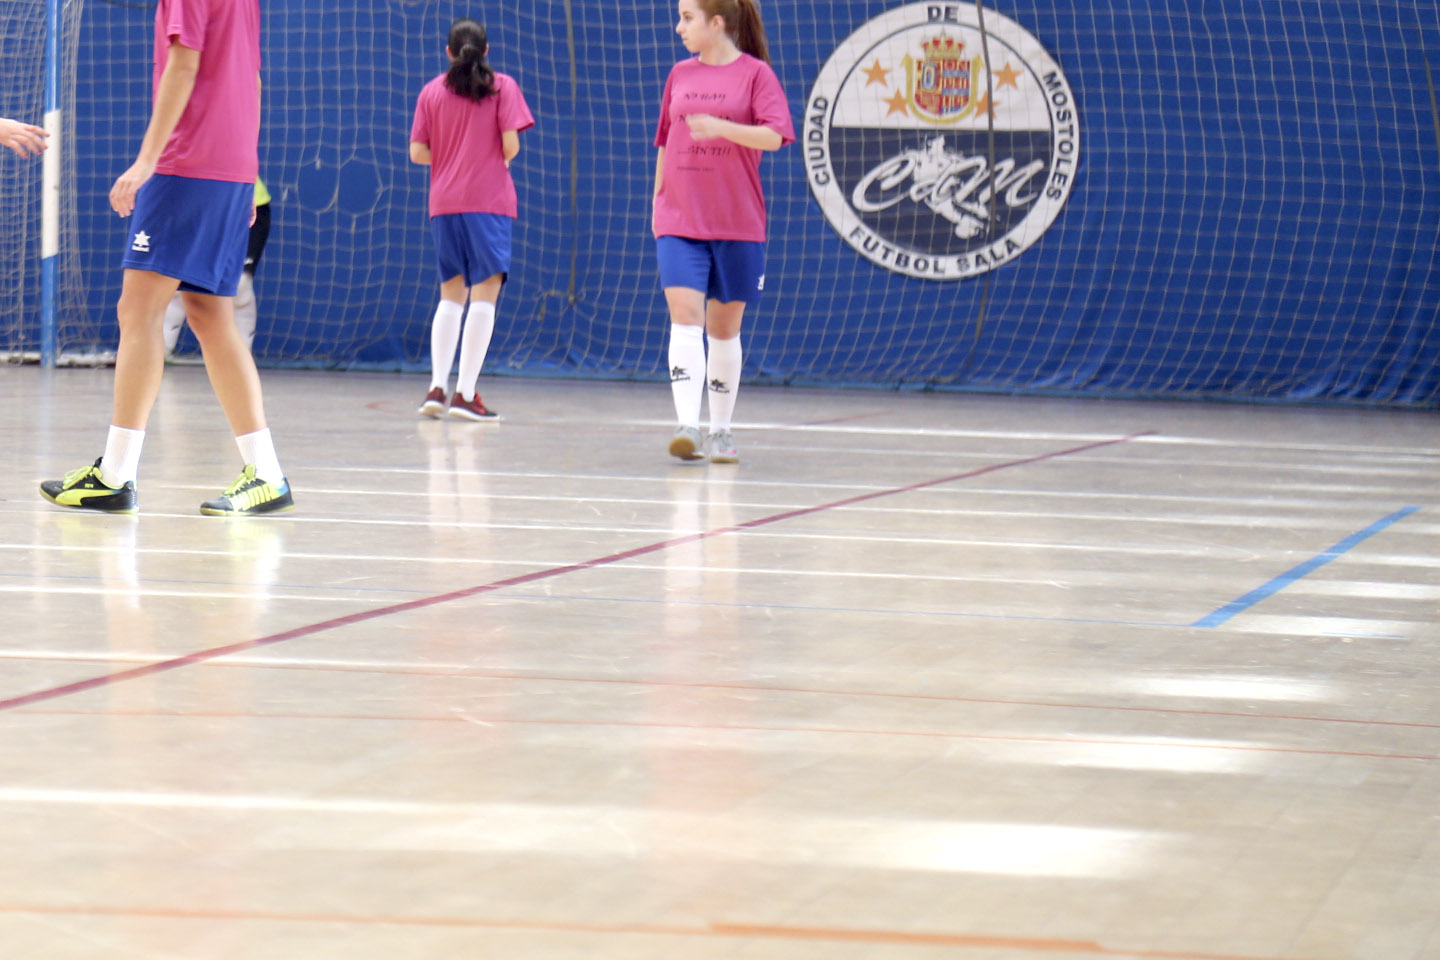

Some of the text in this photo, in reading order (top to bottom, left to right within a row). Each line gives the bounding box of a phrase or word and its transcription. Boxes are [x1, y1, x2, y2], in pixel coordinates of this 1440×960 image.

[927, 5, 959, 23] DE
[808, 96, 830, 186] CIUDAD
[1042, 71, 1074, 200] MOSTOLES
[849, 225, 1023, 274] FUTBOL SALA
